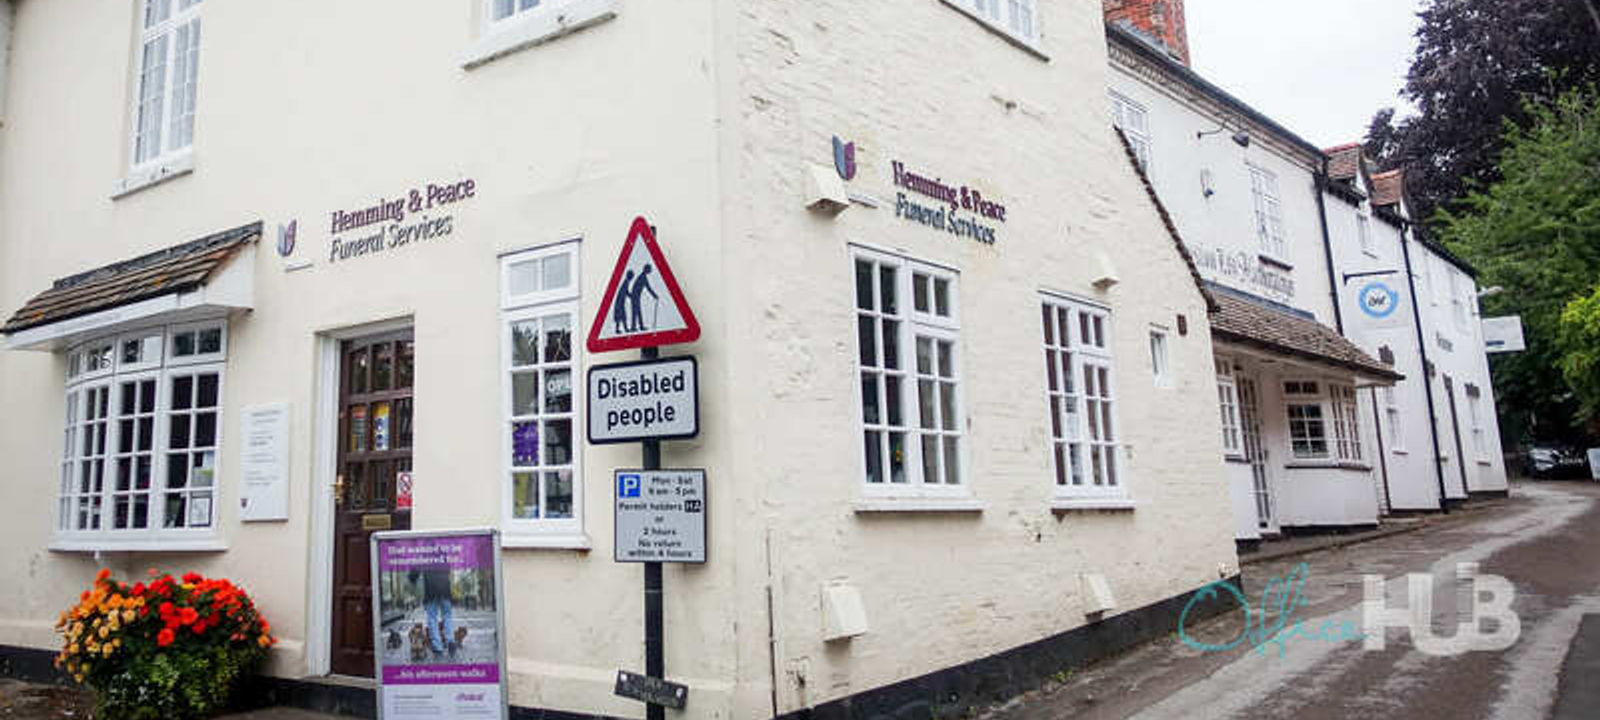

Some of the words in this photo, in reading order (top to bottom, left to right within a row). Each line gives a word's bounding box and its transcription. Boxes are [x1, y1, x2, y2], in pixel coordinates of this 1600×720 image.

[891, 160, 959, 211] Hemming
[960, 186, 973, 210] &
[972, 189, 1007, 223] Peace
[331, 198, 405, 234] Hemming
[408, 189, 424, 214] &
[426, 178, 476, 209] Peace
[895, 191, 945, 230] Funeral
[947, 210, 996, 246] Services
[329, 226, 385, 264] Funeral
[387, 214, 454, 249] Services
[597, 371, 685, 400] Disabled
[607, 402, 676, 431] people
[623, 477, 638, 496] P
[652, 476, 670, 485] Mon
[677, 476, 693, 485] Sat
[619, 501, 647, 511] Permit
[650, 501, 683, 511] holders
[638, 539, 652, 547] No
[653, 539, 682, 547] return
[651, 527, 677, 536] hours
[628, 549, 655, 557] within
[667, 550, 692, 558] hours
